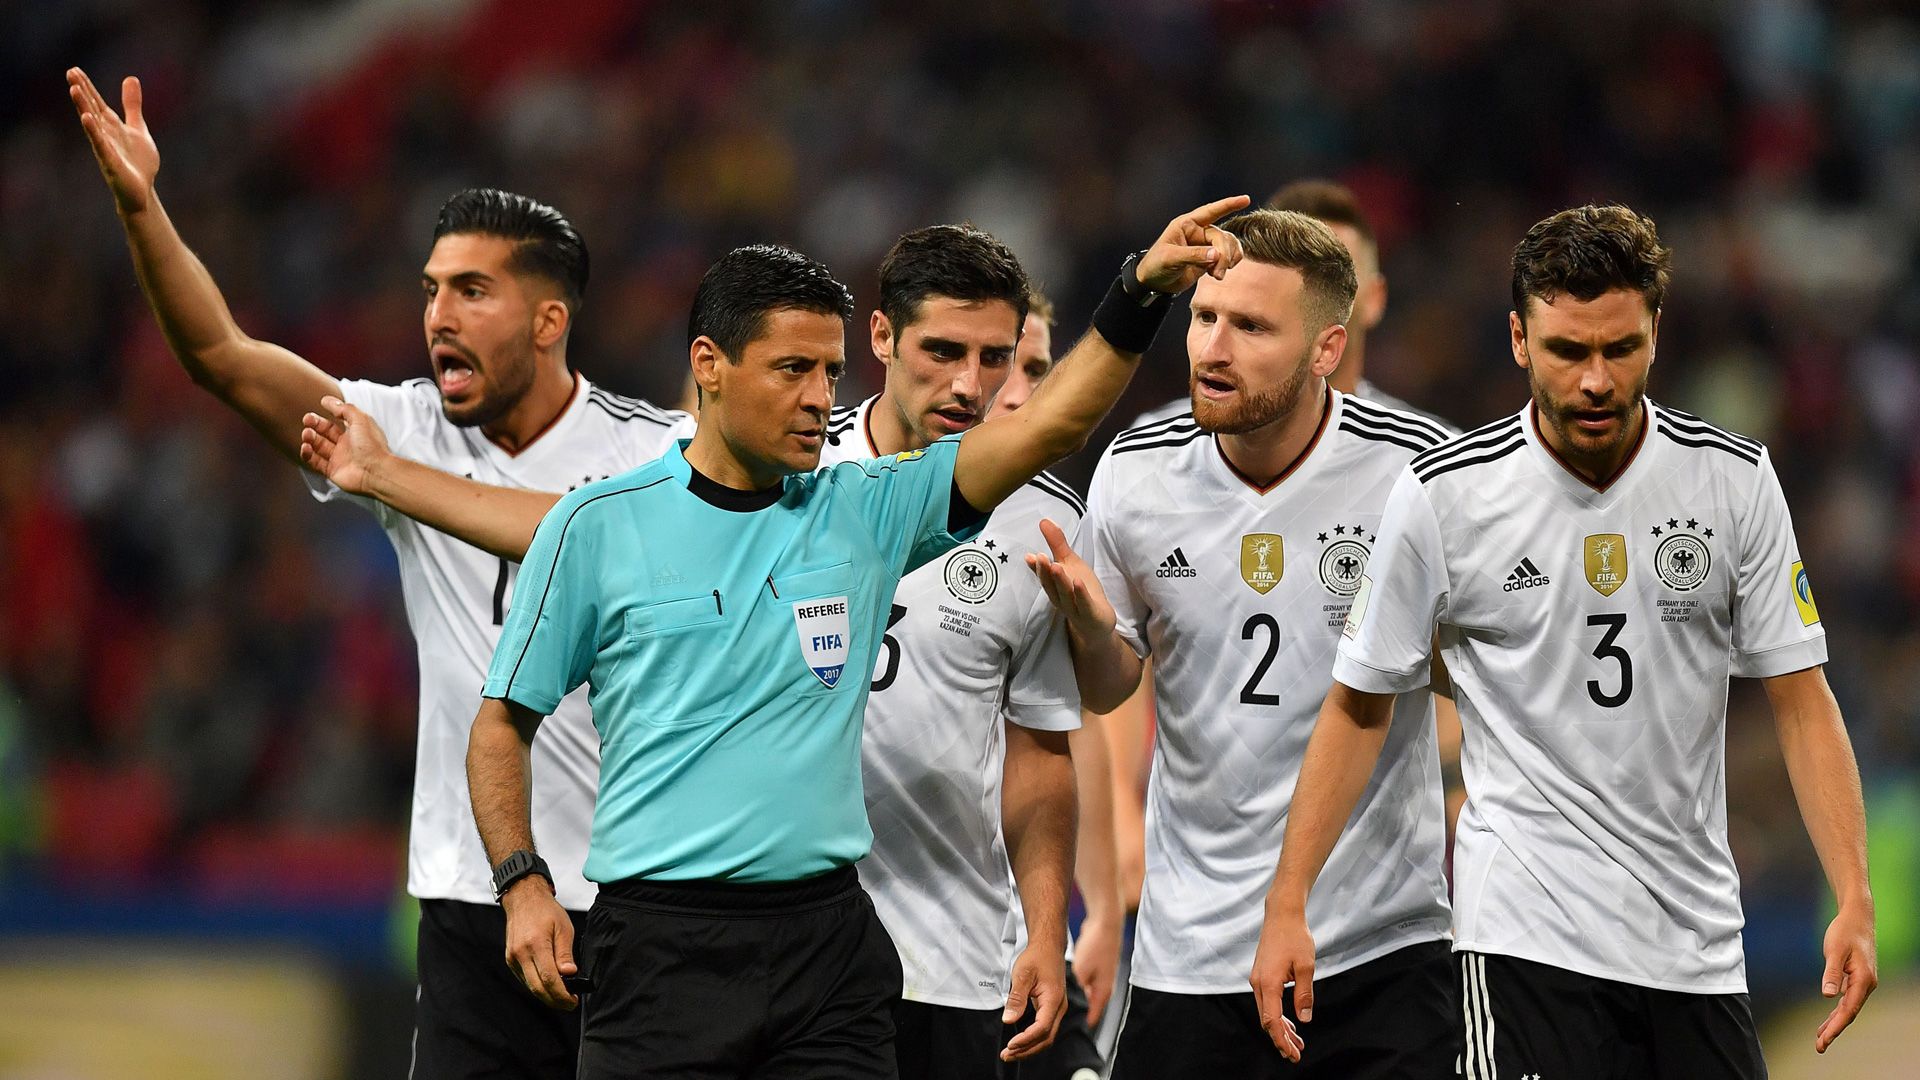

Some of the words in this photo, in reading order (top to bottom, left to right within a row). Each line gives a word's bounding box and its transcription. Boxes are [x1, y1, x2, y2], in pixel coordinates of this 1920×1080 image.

[1667, 541, 1699, 552] DEUTSCHER
[1156, 566, 1196, 578] adidas
[1252, 571, 1273, 580] FIFA
[1596, 573, 1617, 581] FIFA
[1503, 576, 1550, 592] adidas
[798, 603, 845, 620] REFEREE
[812, 633, 843, 651] FIFA
[1240, 613, 1281, 706] 2
[1586, 612, 1634, 708] 3
[823, 669, 840, 680] 2017
